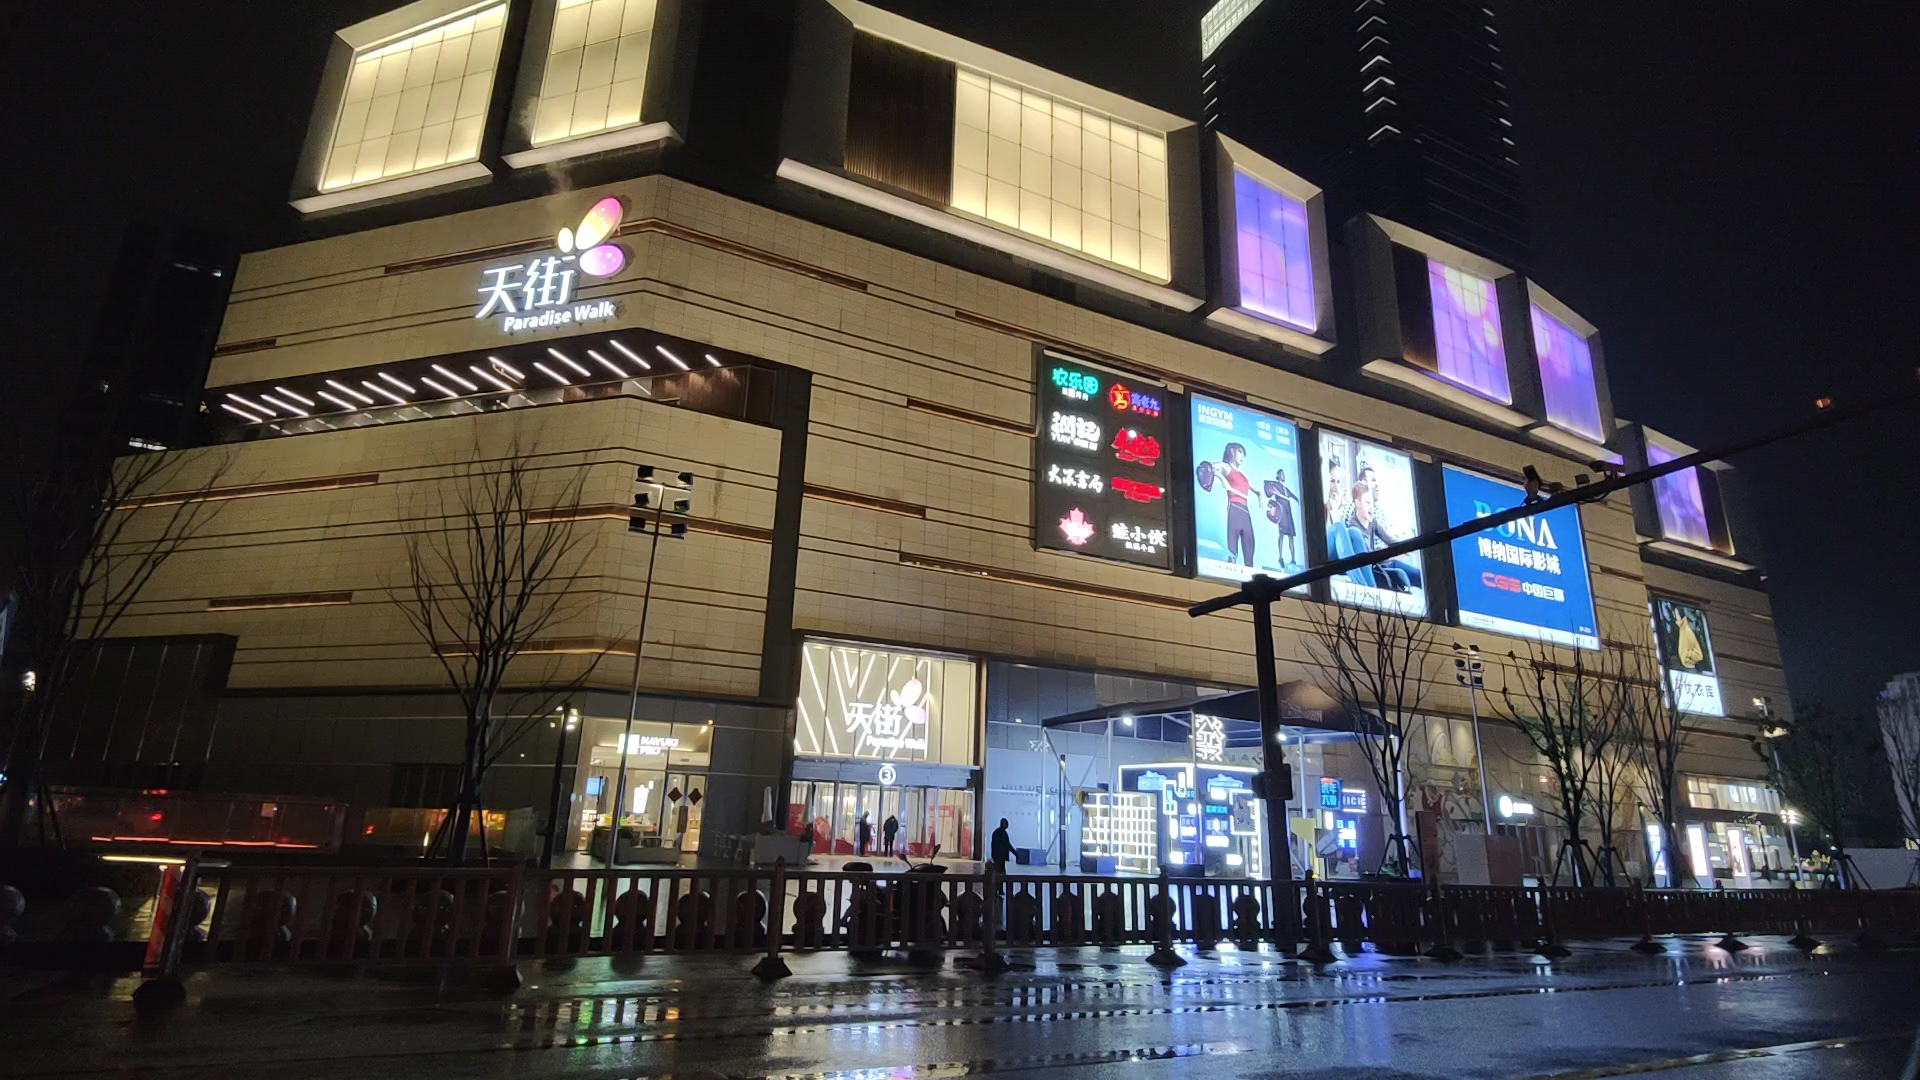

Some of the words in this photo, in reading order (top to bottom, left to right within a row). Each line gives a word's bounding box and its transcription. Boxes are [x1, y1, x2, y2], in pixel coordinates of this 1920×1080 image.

[475, 254, 576, 319] 天街
[504, 308, 572, 332] Paradise
[574, 301, 616, 321] Walk
[1197, 404, 1233, 423] INGYM
[1478, 536, 1562, 576] 博纳国际影城
[1521, 581, 1565, 603] 中国巨幕
[846, 703, 903, 736] 天街
